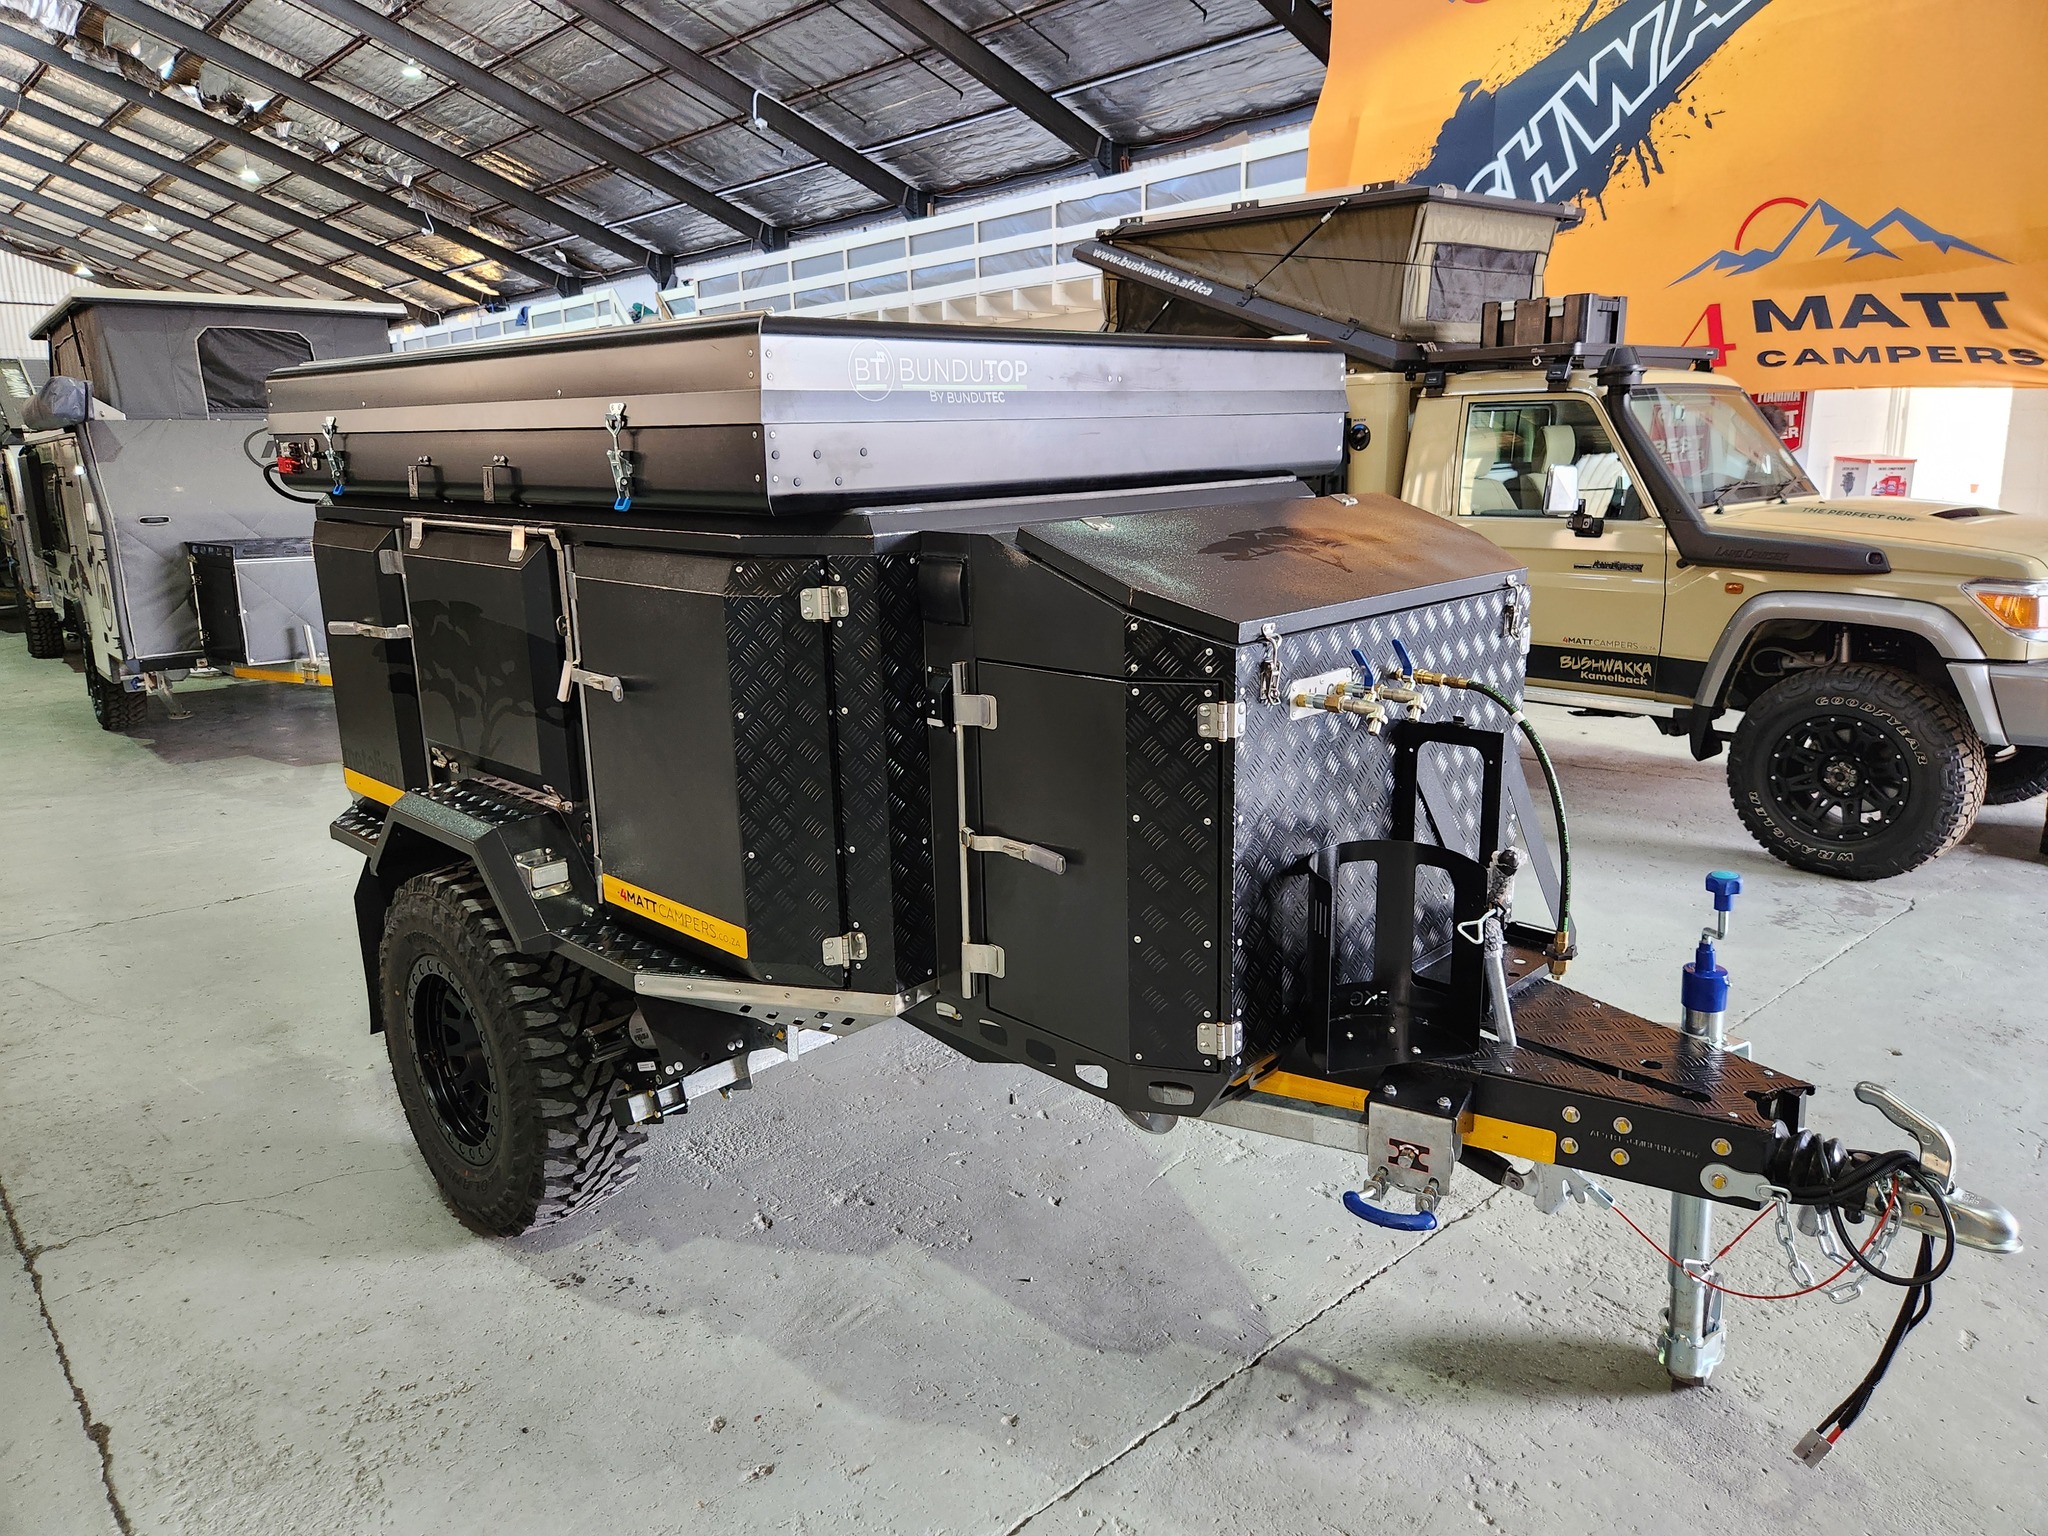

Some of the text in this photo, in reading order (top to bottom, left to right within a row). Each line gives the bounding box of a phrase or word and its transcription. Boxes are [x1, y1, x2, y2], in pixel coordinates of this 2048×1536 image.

[1092, 248, 1214, 297] www.bushwakka.africa
[1682, 291, 2010, 367] 4 MATT
[1756, 346, 2048, 368] CAMPERS
[899, 357, 1028, 384] BUNDUTOP
[929, 390, 1006, 404] BY BUNDUTEC
[1802, 506, 1916, 522] THE PERFECT ONE
[1559, 655, 1652, 678] BUSHWAKKA
[1580, 670, 1648, 686] Kamelback
[1815, 696, 1929, 766] GOODYEAR
[1749, 791, 1855, 862] WRANGLER
